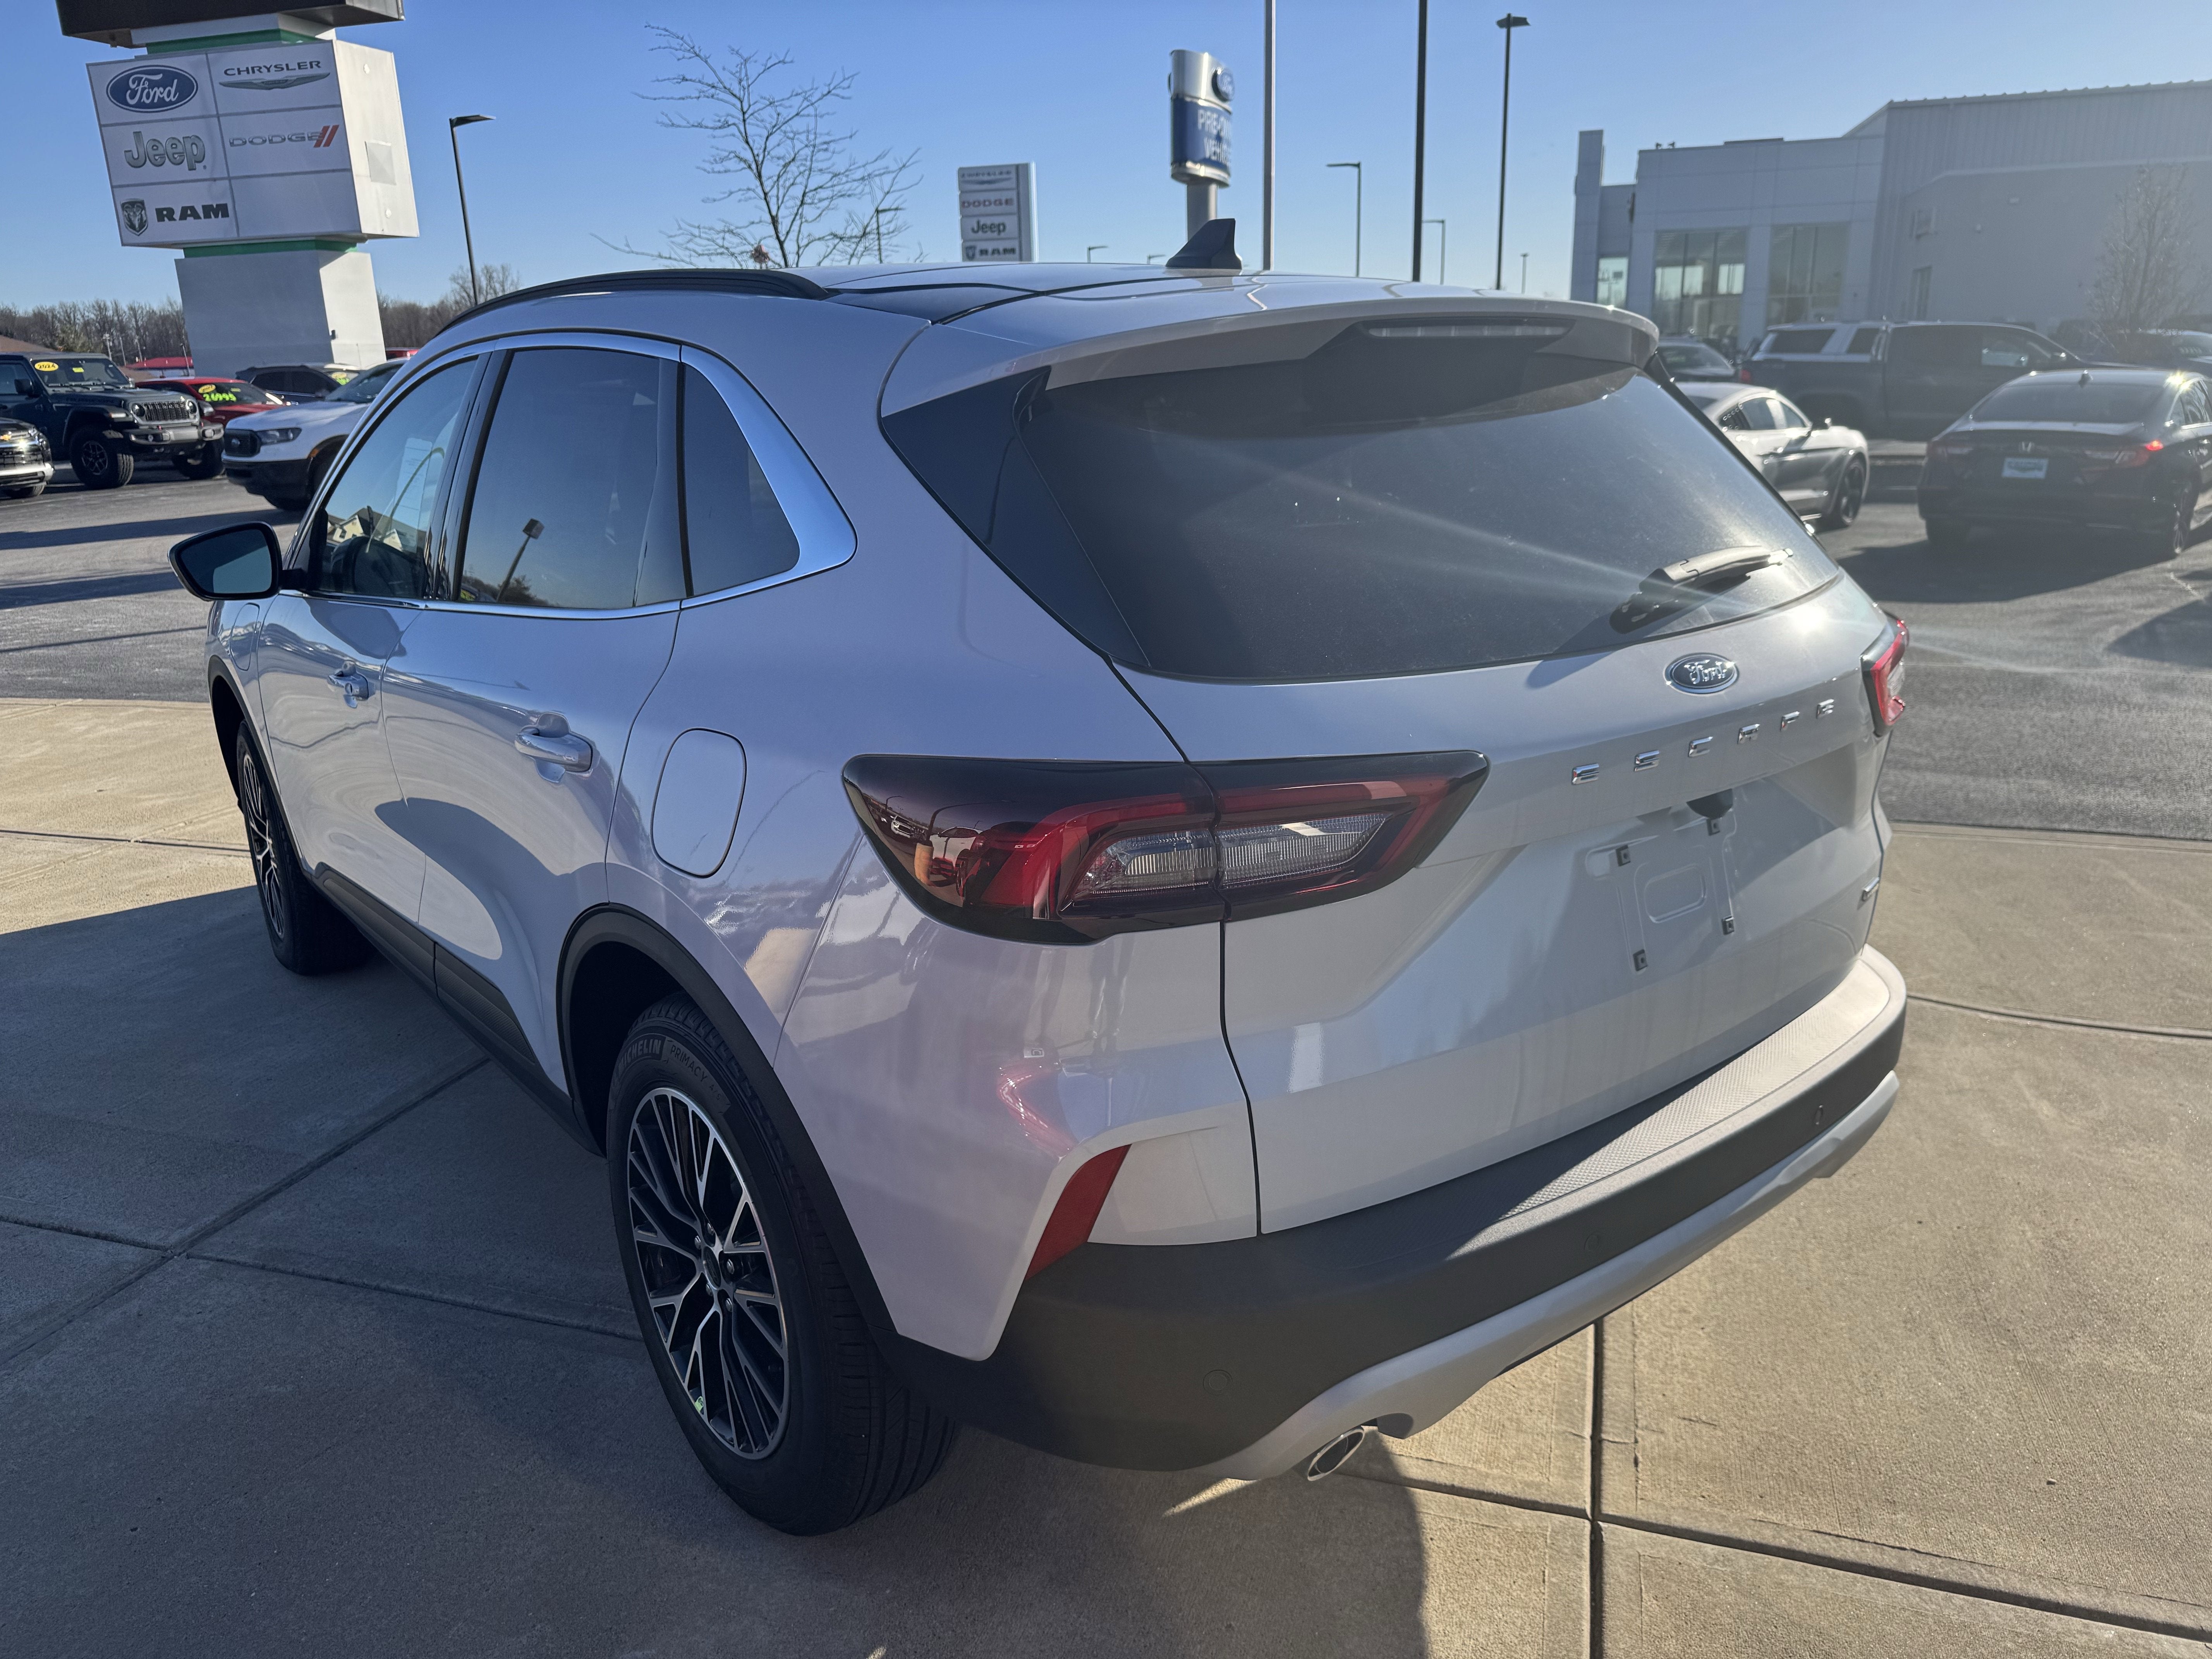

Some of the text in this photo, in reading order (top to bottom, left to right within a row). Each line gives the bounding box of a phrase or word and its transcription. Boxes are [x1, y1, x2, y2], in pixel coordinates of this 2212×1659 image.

[223, 60, 321, 76] CHRYSLER
[126, 73, 179, 105] Ford
[124, 131, 206, 171] Jeep
[229, 131, 324, 147] DODGE
[155, 203, 230, 222] RAM
[971, 219, 1006, 235] Jeep
[1684, 659, 1728, 684] Ford
[1571, 699, 1835, 785] ESCAPE
[670, 1044, 708, 1082] PRIMACY
